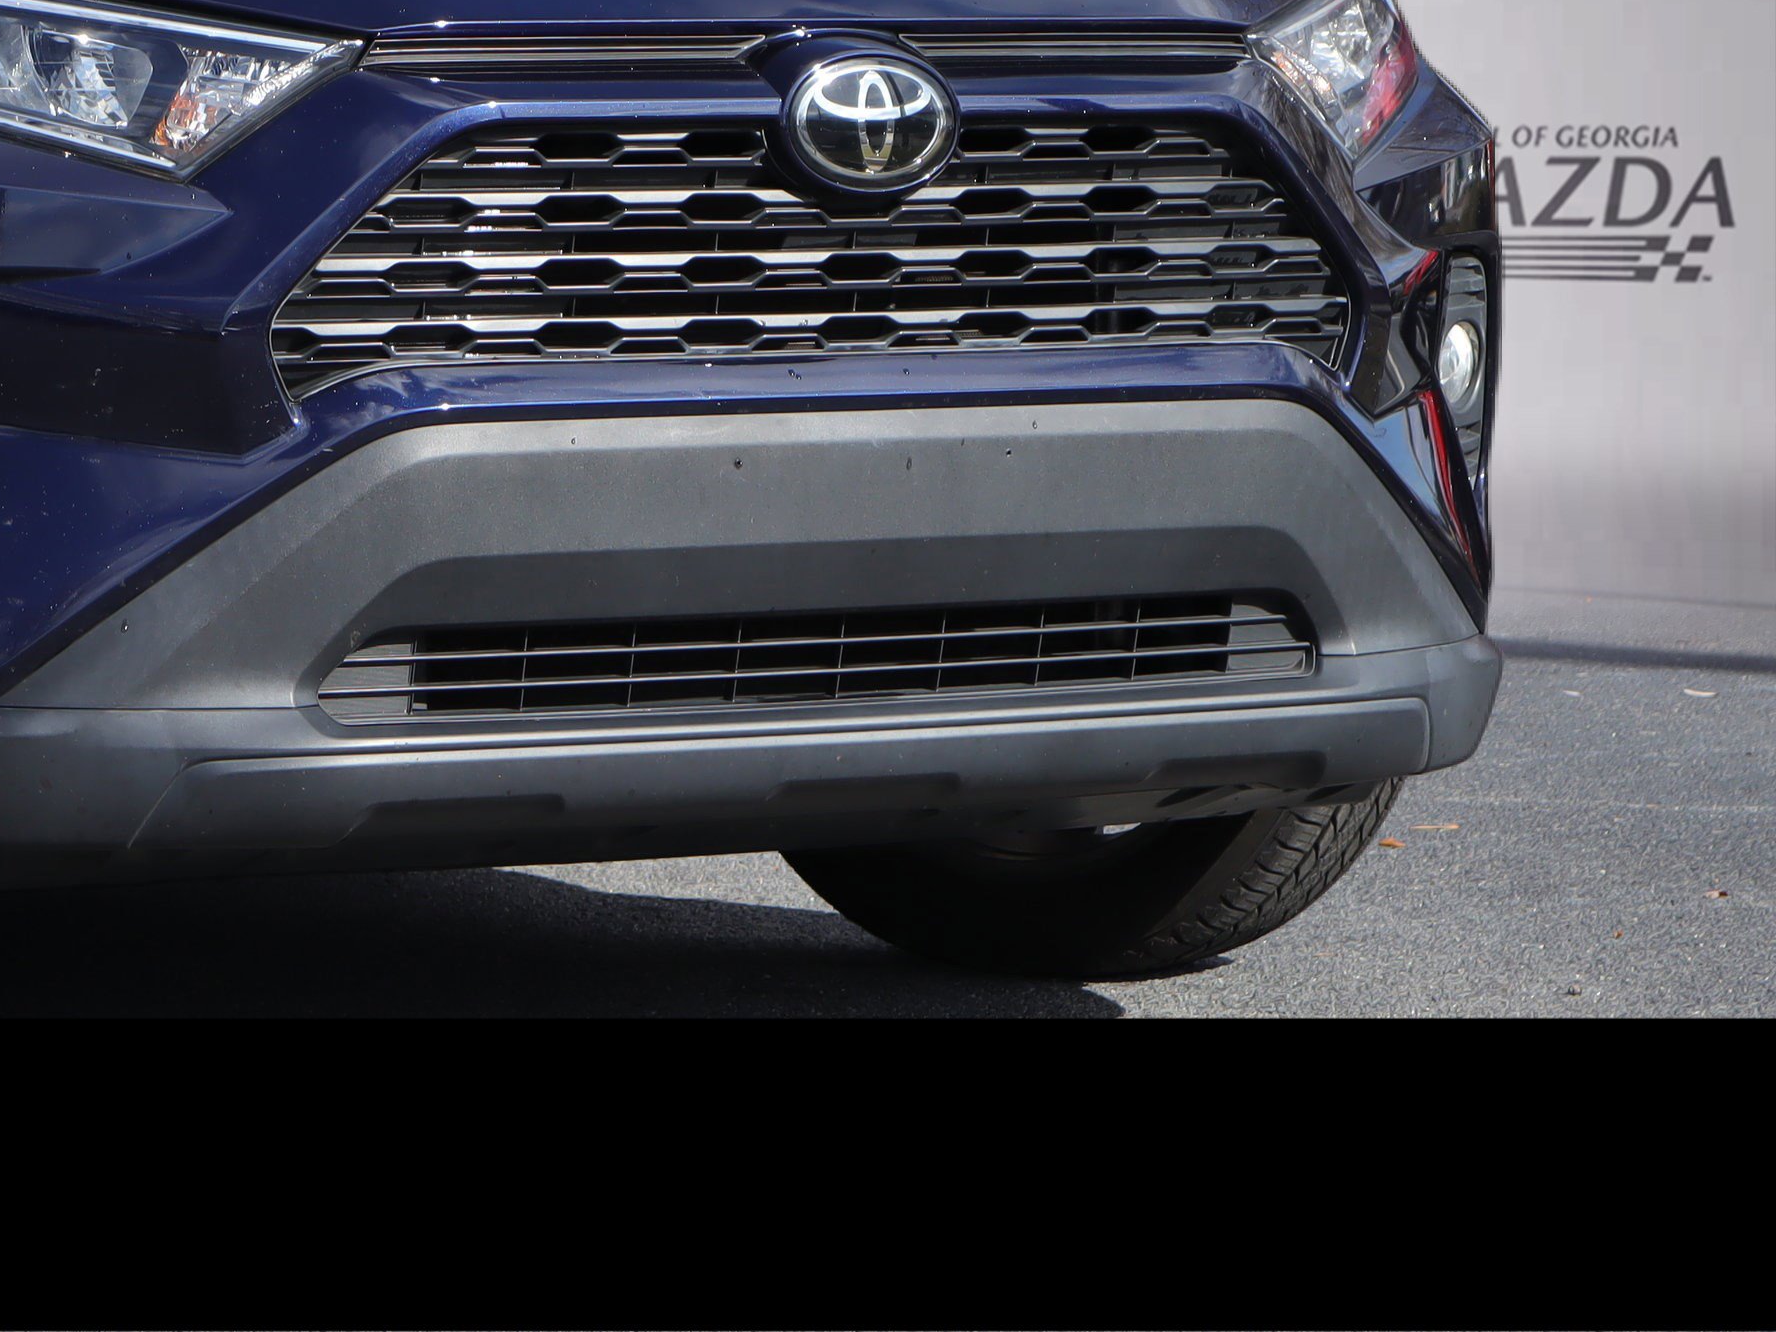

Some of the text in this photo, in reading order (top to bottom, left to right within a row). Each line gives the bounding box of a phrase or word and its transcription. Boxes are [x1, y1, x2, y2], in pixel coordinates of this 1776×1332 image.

[1512, 125, 1549, 148] OF
[1555, 124, 1679, 148] GEORGIA
[1495, 156, 1736, 228] AZDA
